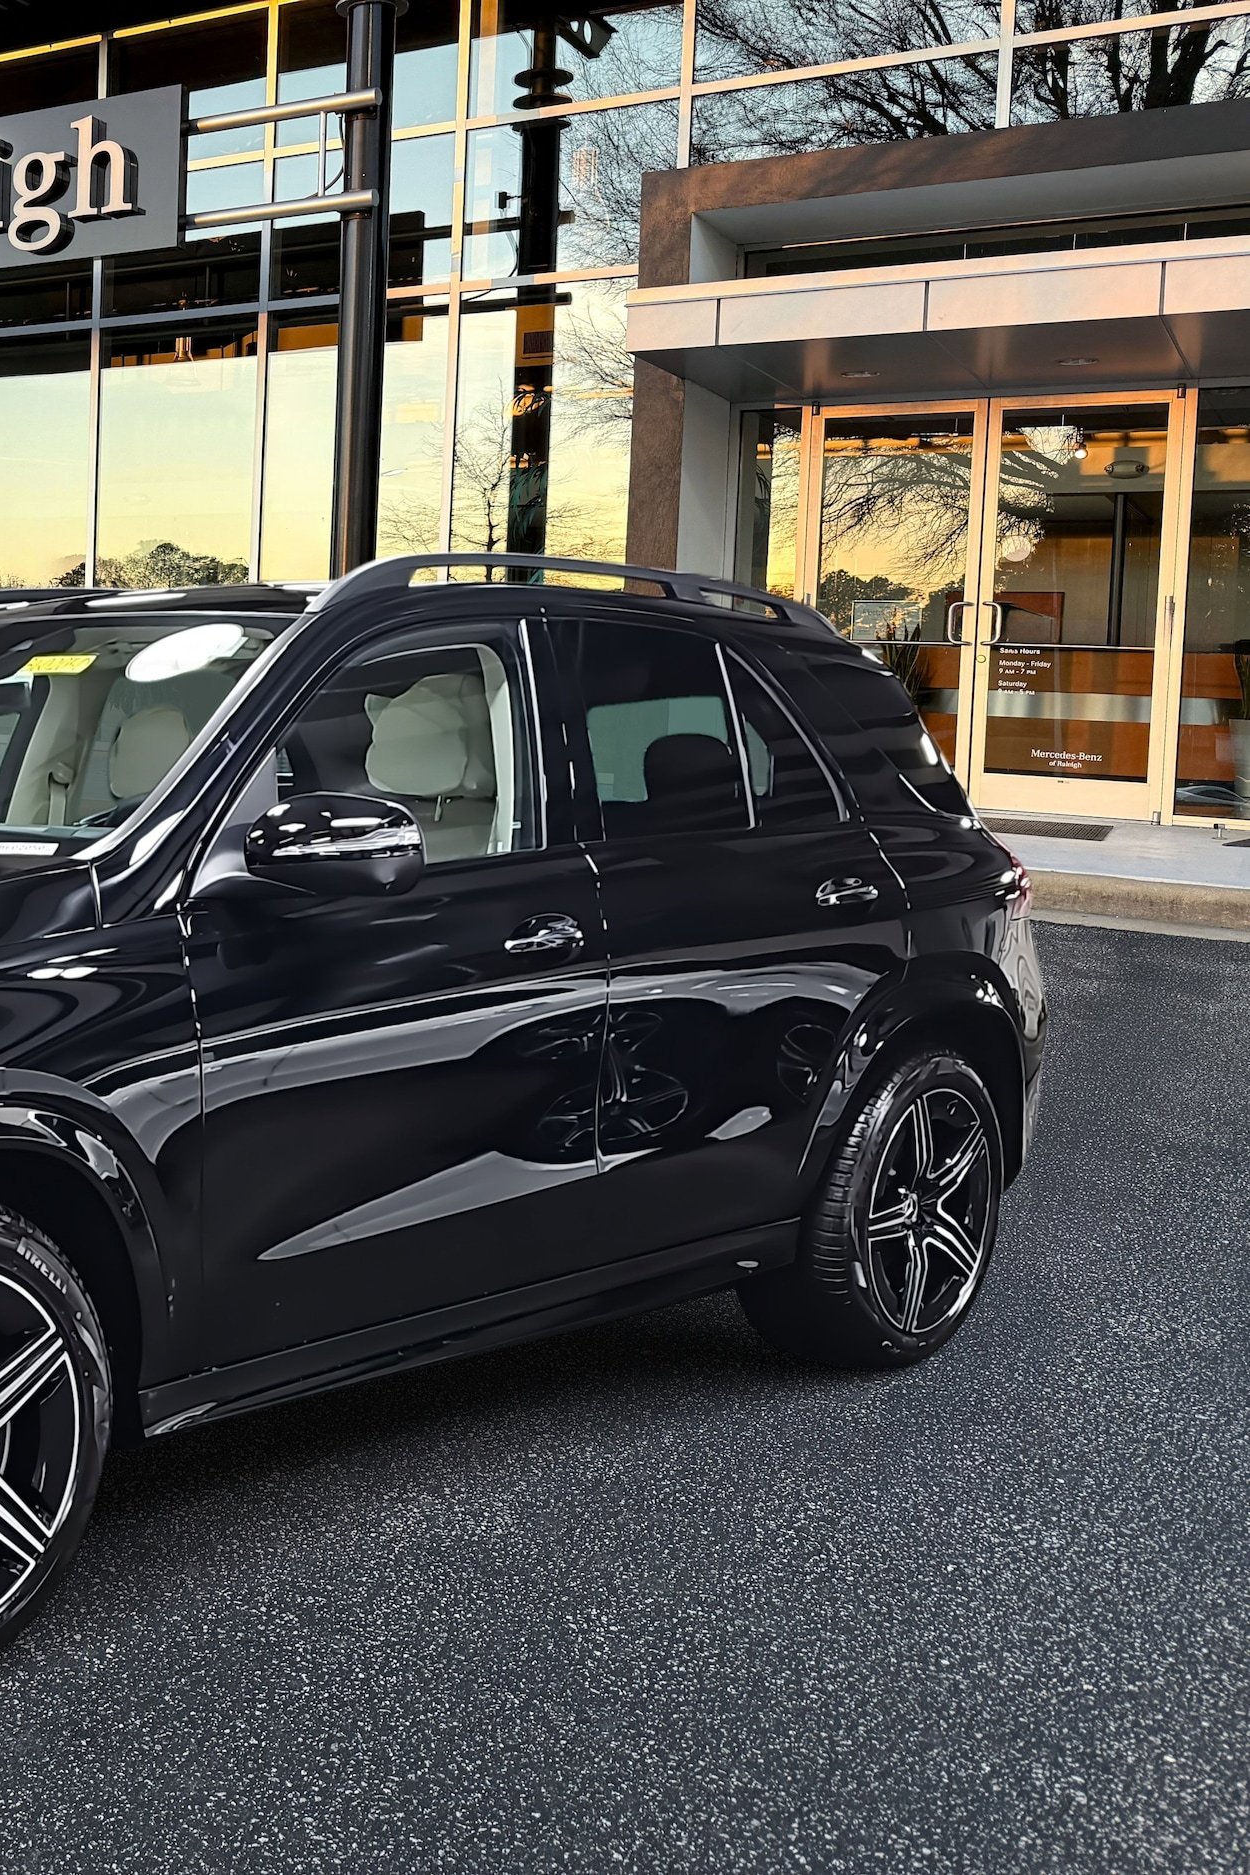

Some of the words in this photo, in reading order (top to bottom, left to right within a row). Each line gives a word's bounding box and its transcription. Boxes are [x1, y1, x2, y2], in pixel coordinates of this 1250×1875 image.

[998, 680, 1027, 688] Saturday
[1030, 749, 1102, 762] Mercedes-Benz
[16, 1236, 68, 1295] PIRELLI
